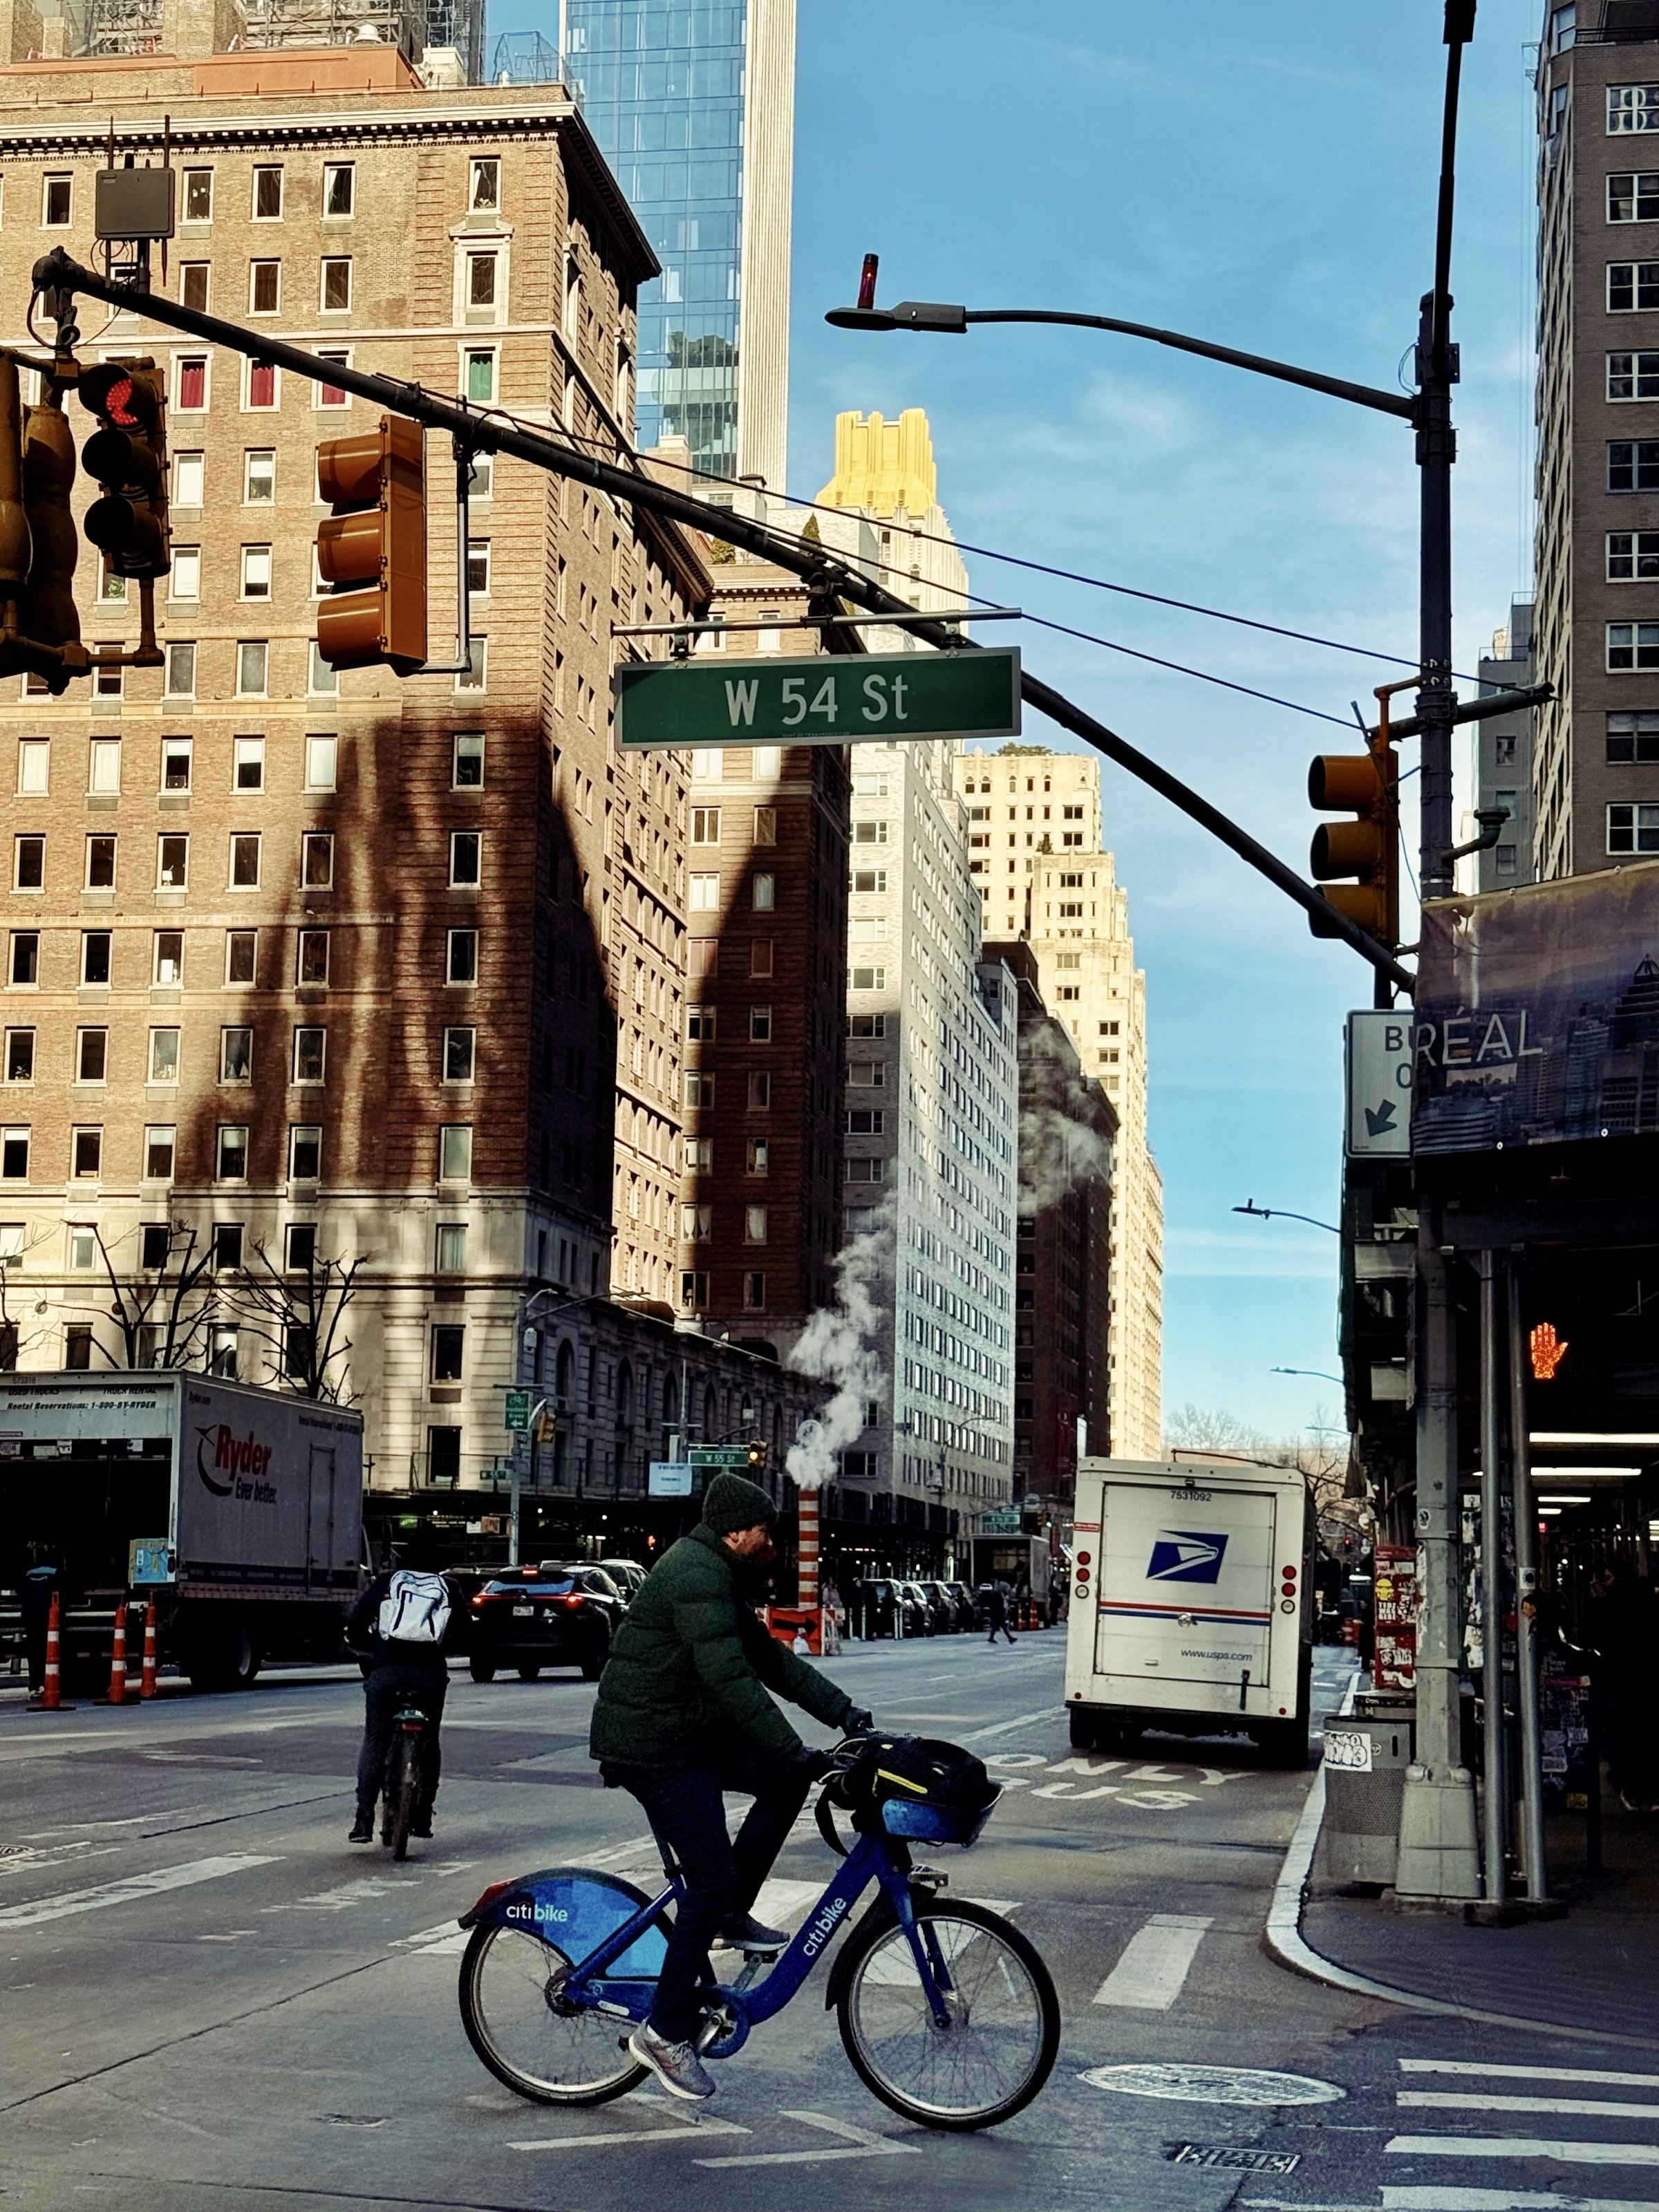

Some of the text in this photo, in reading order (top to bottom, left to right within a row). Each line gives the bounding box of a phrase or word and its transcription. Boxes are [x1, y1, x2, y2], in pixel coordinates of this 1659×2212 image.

[724, 674, 908, 726] W 54 St
[1385, 1026, 1413, 1051] B
[8, 1385, 157, 1396] USED TRUCKS TRUCK RENTAL
[215, 1424, 272, 1481] Ryder
[706, 1454, 735, 1463] W 55 St
[235, 1477, 254, 1501] Ever
[1170, 1491, 1212, 1501] 7531092
[1181, 1649, 1253, 1661] www.usps.com
[982, 1754, 1258, 1785] ONLY
